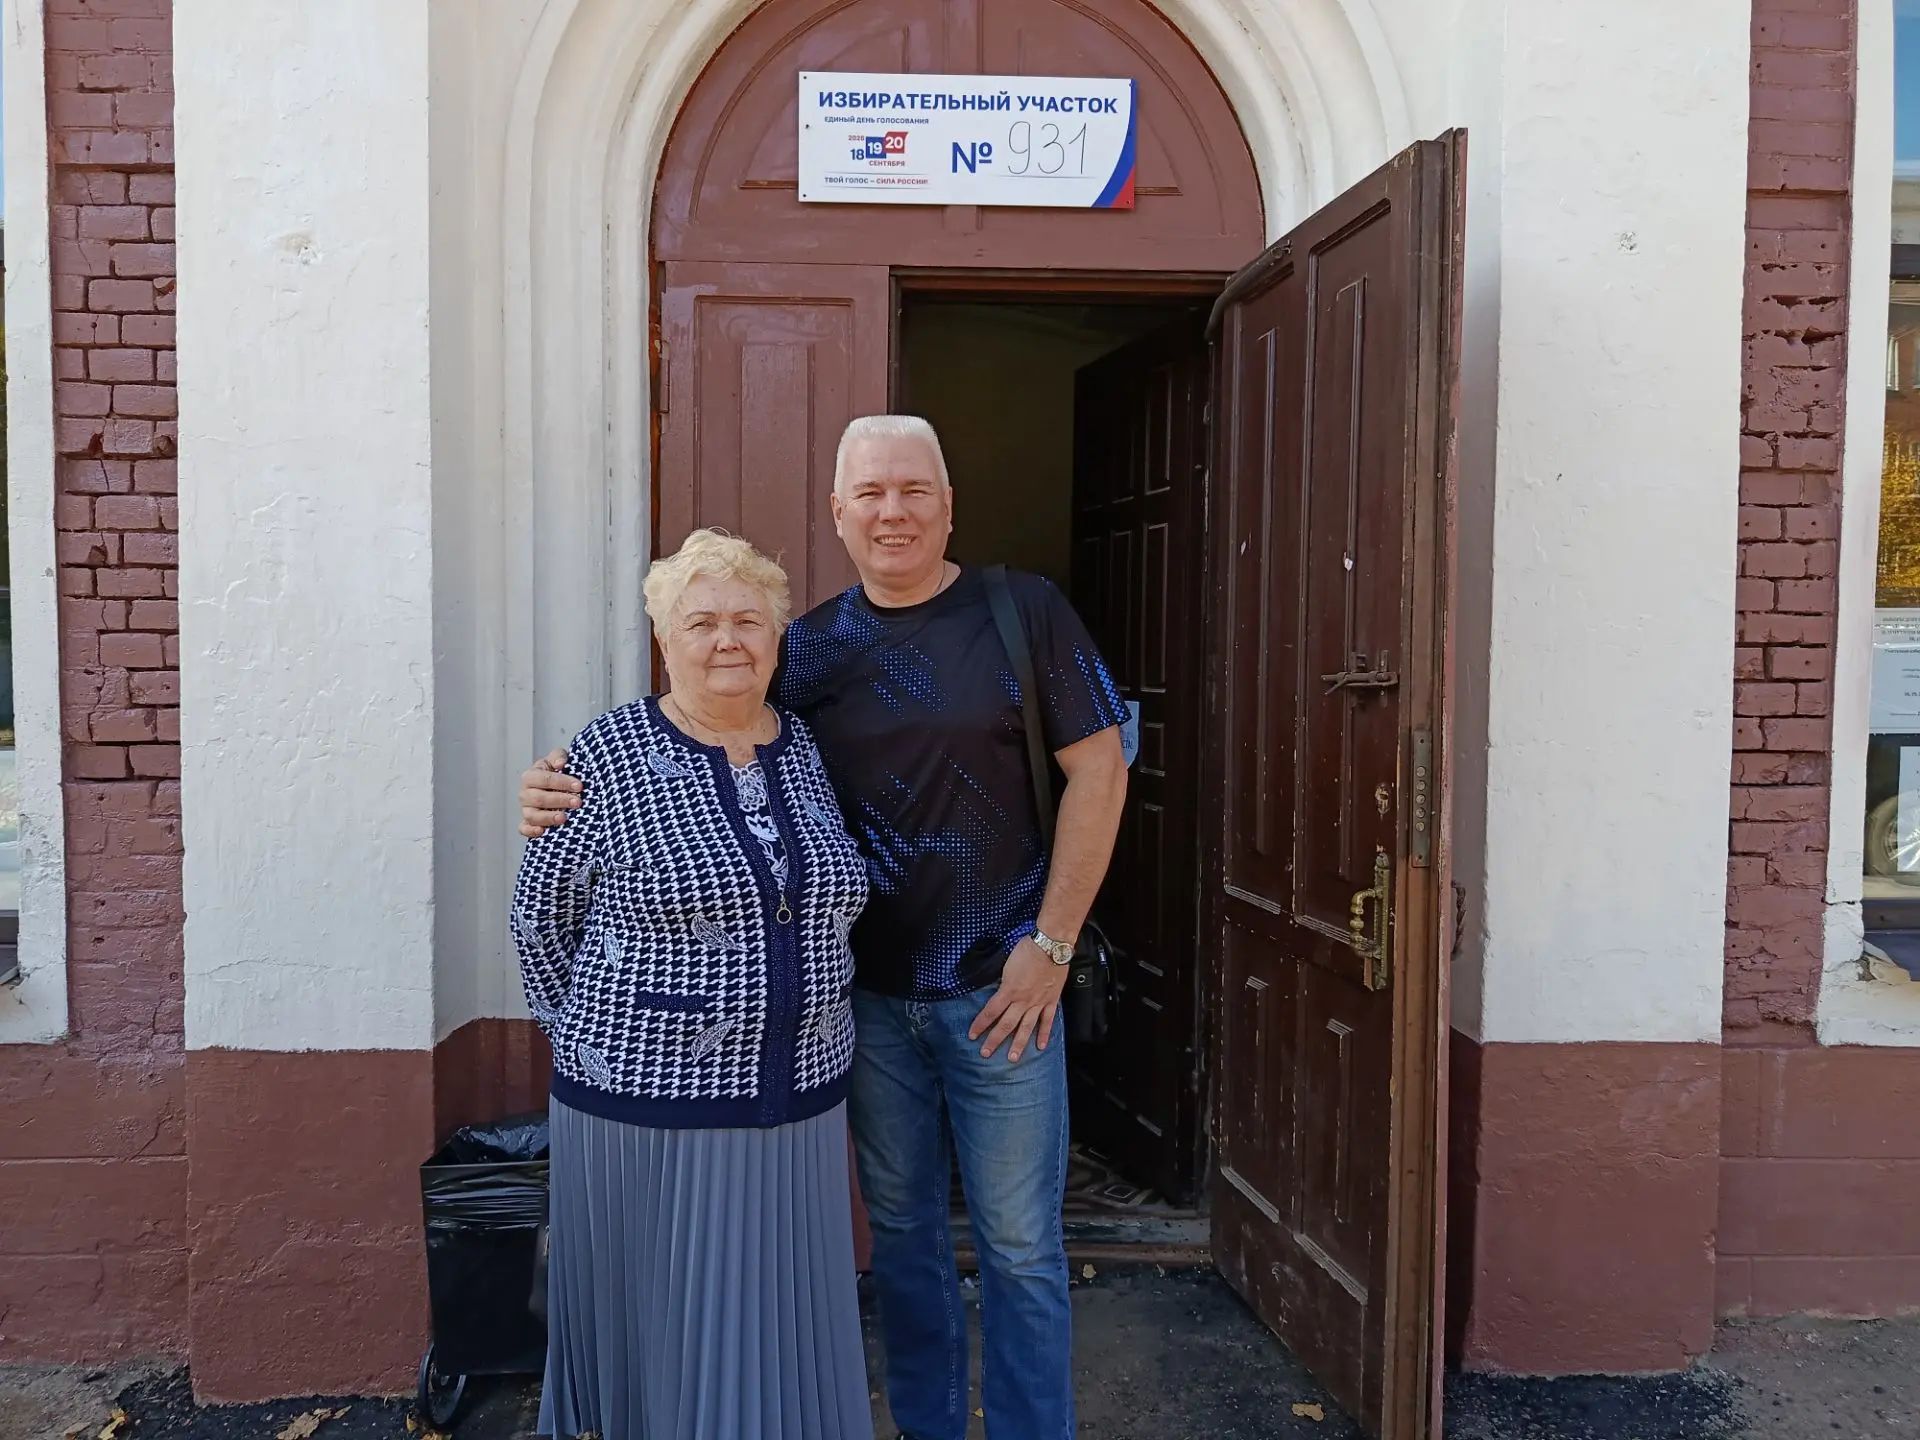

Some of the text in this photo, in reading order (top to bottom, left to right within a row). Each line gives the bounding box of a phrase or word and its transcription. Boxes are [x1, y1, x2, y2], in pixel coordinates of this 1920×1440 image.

[819, 90, 1118, 114] ИЗБИРАТЕЛЬНЫЙ УЧАСТОК
[850, 137, 904, 160] 18 19 20
[951, 121, 1087, 174] № 931
[824, 176, 844, 184] ТВОЙ
